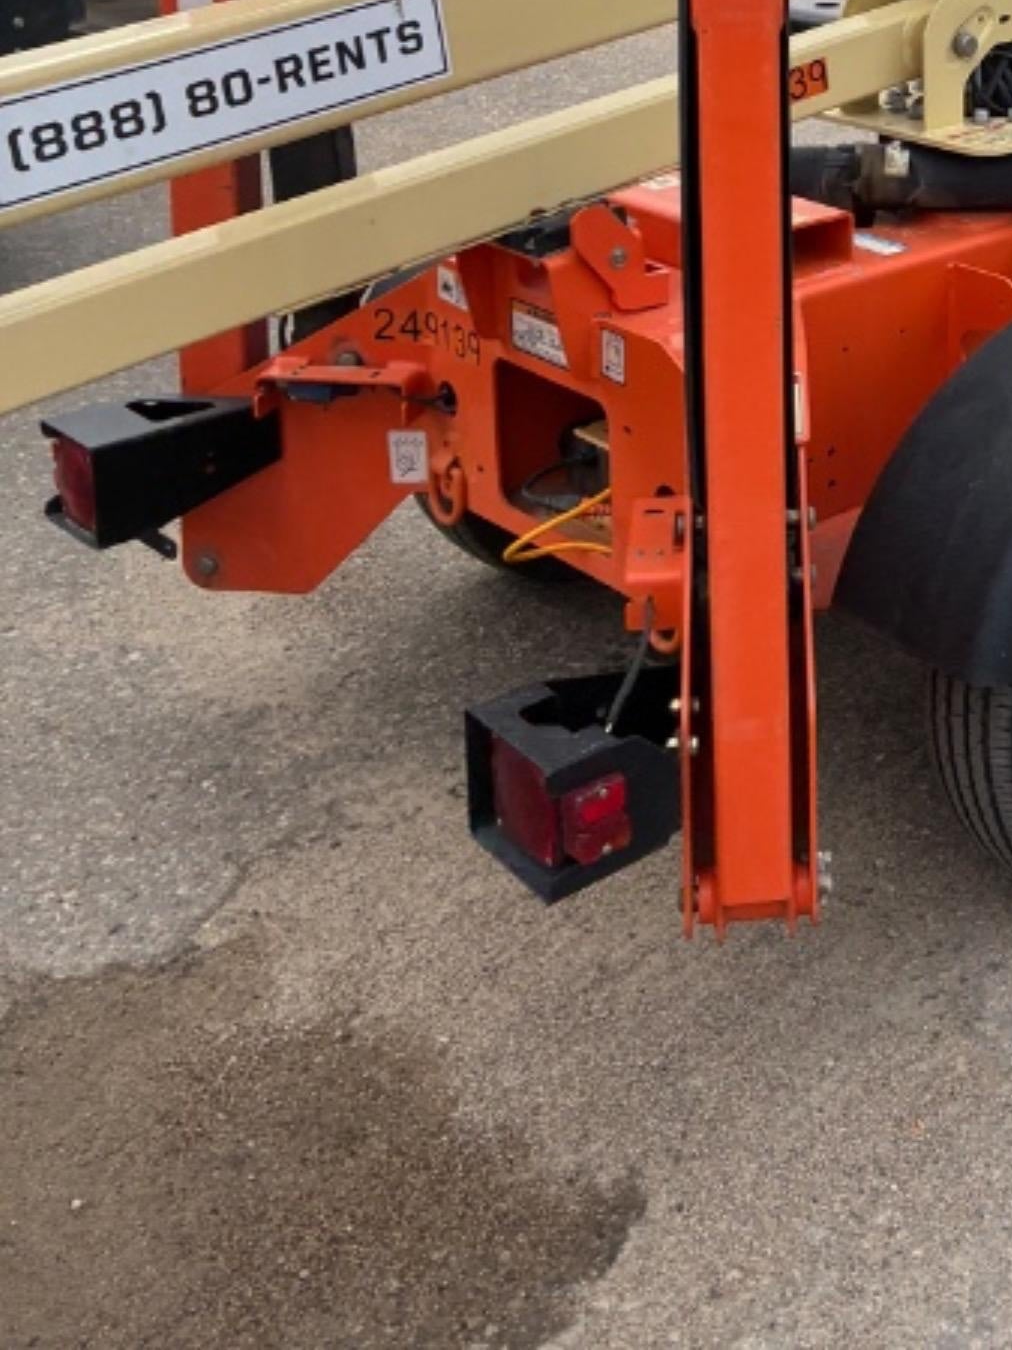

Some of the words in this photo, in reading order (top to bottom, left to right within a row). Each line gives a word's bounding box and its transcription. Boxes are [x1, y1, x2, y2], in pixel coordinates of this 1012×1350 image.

[7, 91, 167, 172] (888)
[185, 20, 425, 119] 80-RENTS
[373, 307, 481, 367] 249139
